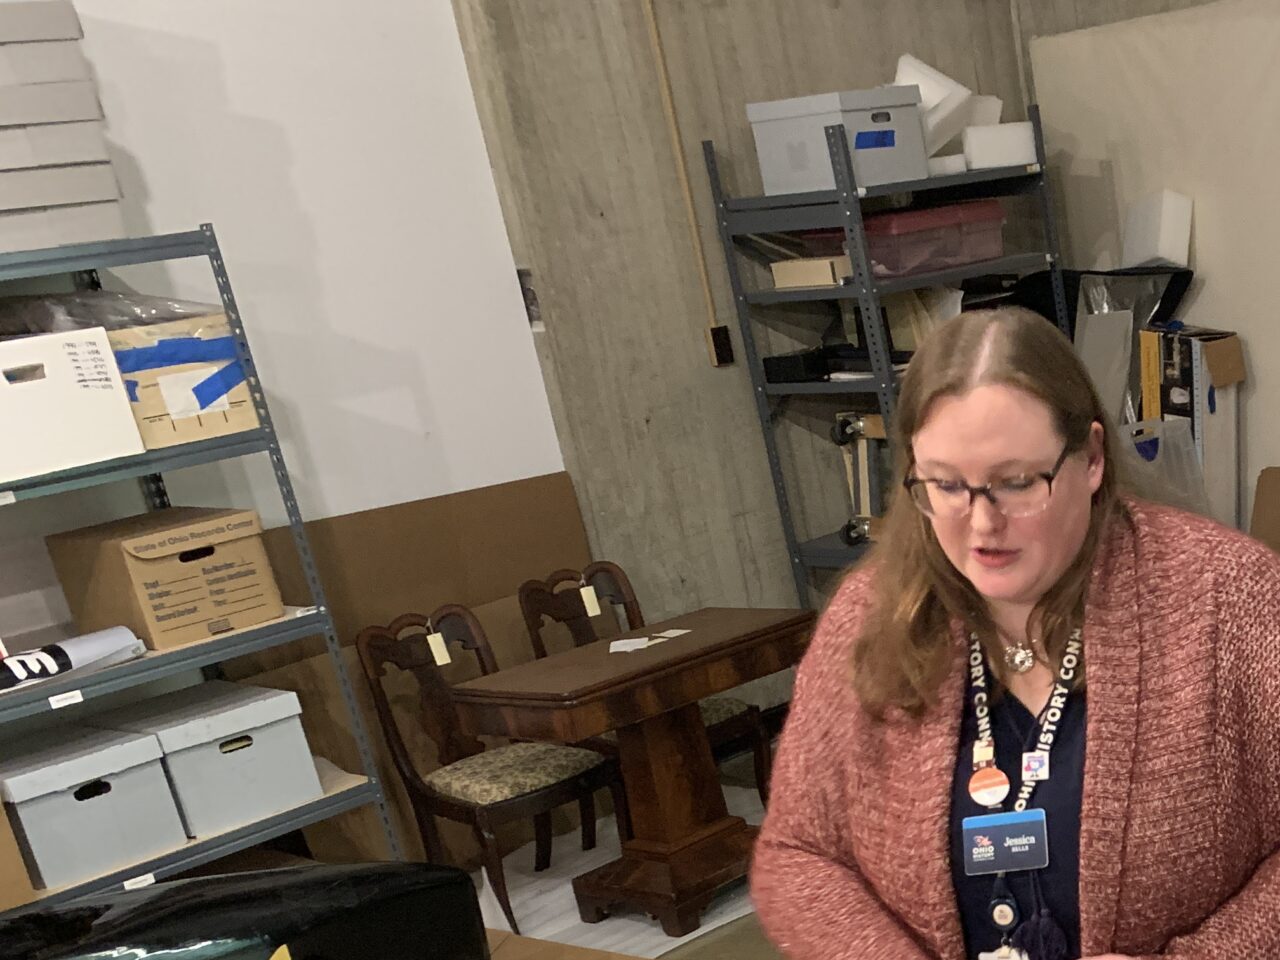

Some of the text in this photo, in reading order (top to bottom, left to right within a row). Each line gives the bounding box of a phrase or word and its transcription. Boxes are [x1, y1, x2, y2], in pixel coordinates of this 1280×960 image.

[167, 535, 189, 546] Ohio
[190, 526, 226, 542] Records
[1014, 779, 1037, 813] OHI
[1003, 834, 1036, 847] Jessica
